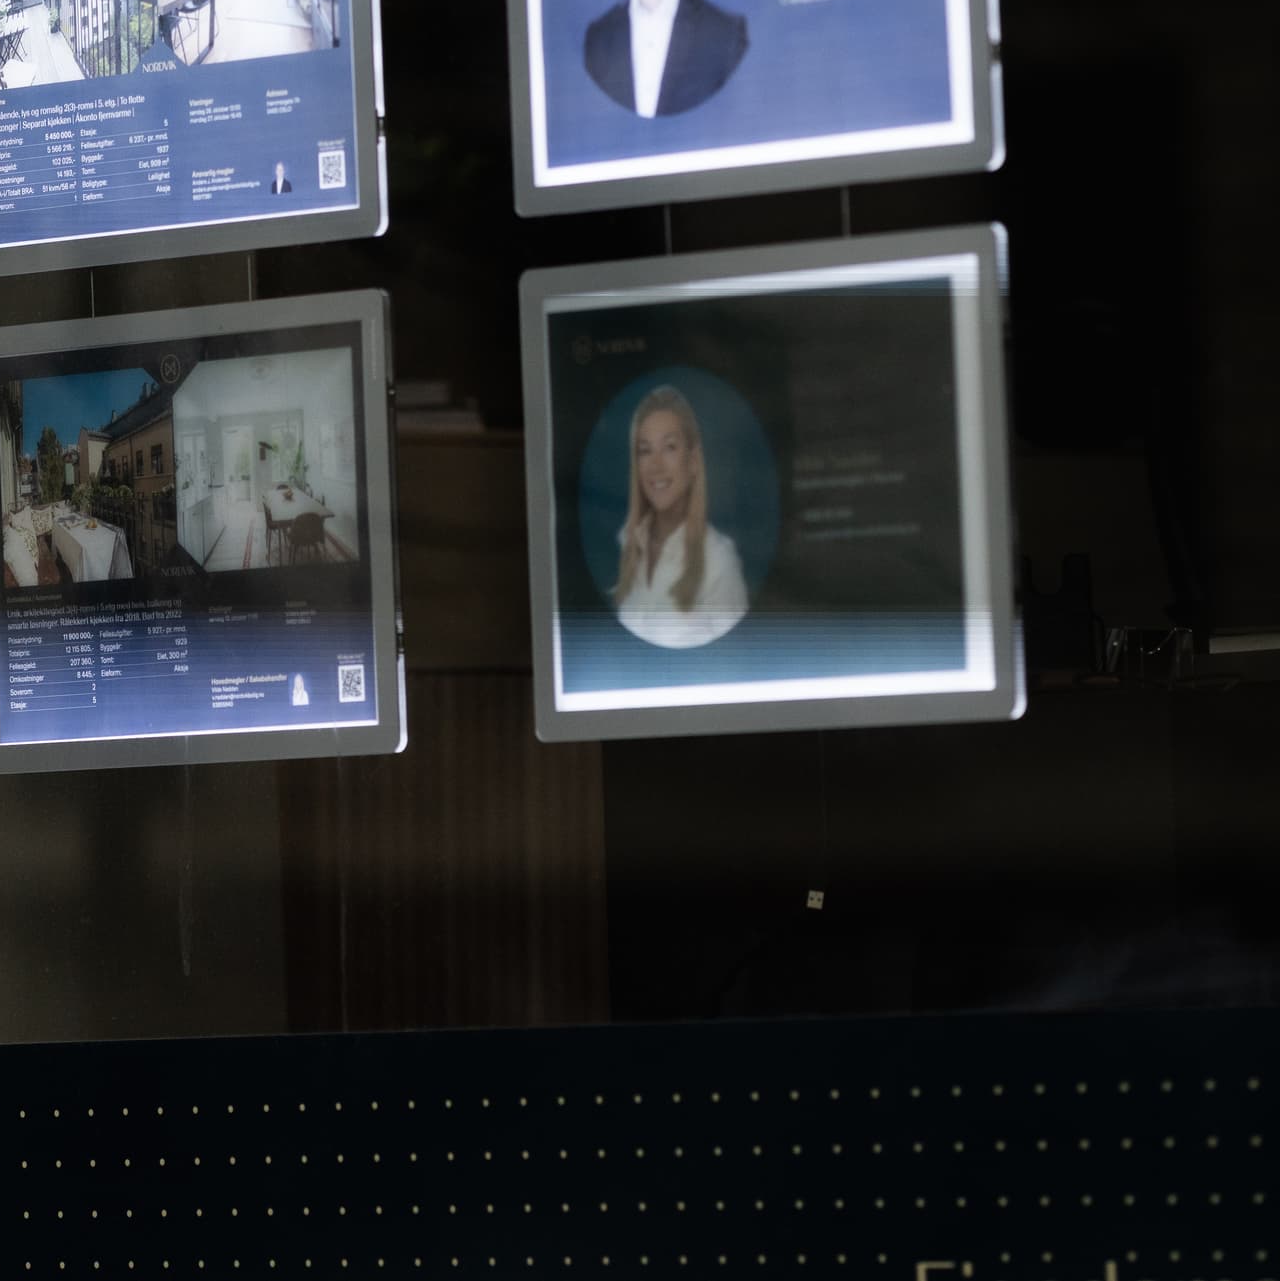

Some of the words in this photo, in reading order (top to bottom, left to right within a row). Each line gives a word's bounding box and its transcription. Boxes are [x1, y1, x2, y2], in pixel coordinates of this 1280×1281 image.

[142, 60, 177, 73] NORDVIK
[21, 108, 30, 120] lys
[31, 108, 39, 118] og
[40, 105, 63, 116] romslig
[64, 101, 94, 113] 2(3)-roms
[120, 96, 128, 105] To
[128, 95, 145, 105] flotte
[22, 118, 47, 131] Separat
[47, 116, 72, 128] kjøkken
[98, 109, 132, 122] fjernvarme
[60, 130, 75, 140] 000,-
[21, 186, 35, 195] BRA:
[8, 621, 29, 631] smarte
[90, 614, 114, 626] kjøkken
[115, 613, 124, 622] fra
[142, 610, 155, 620] Bad
[155, 610, 165, 619] fra
[80, 630, 94, 639] 000,-
[91, 683, 96, 691] 2
[91, 696, 97, 704] 5
